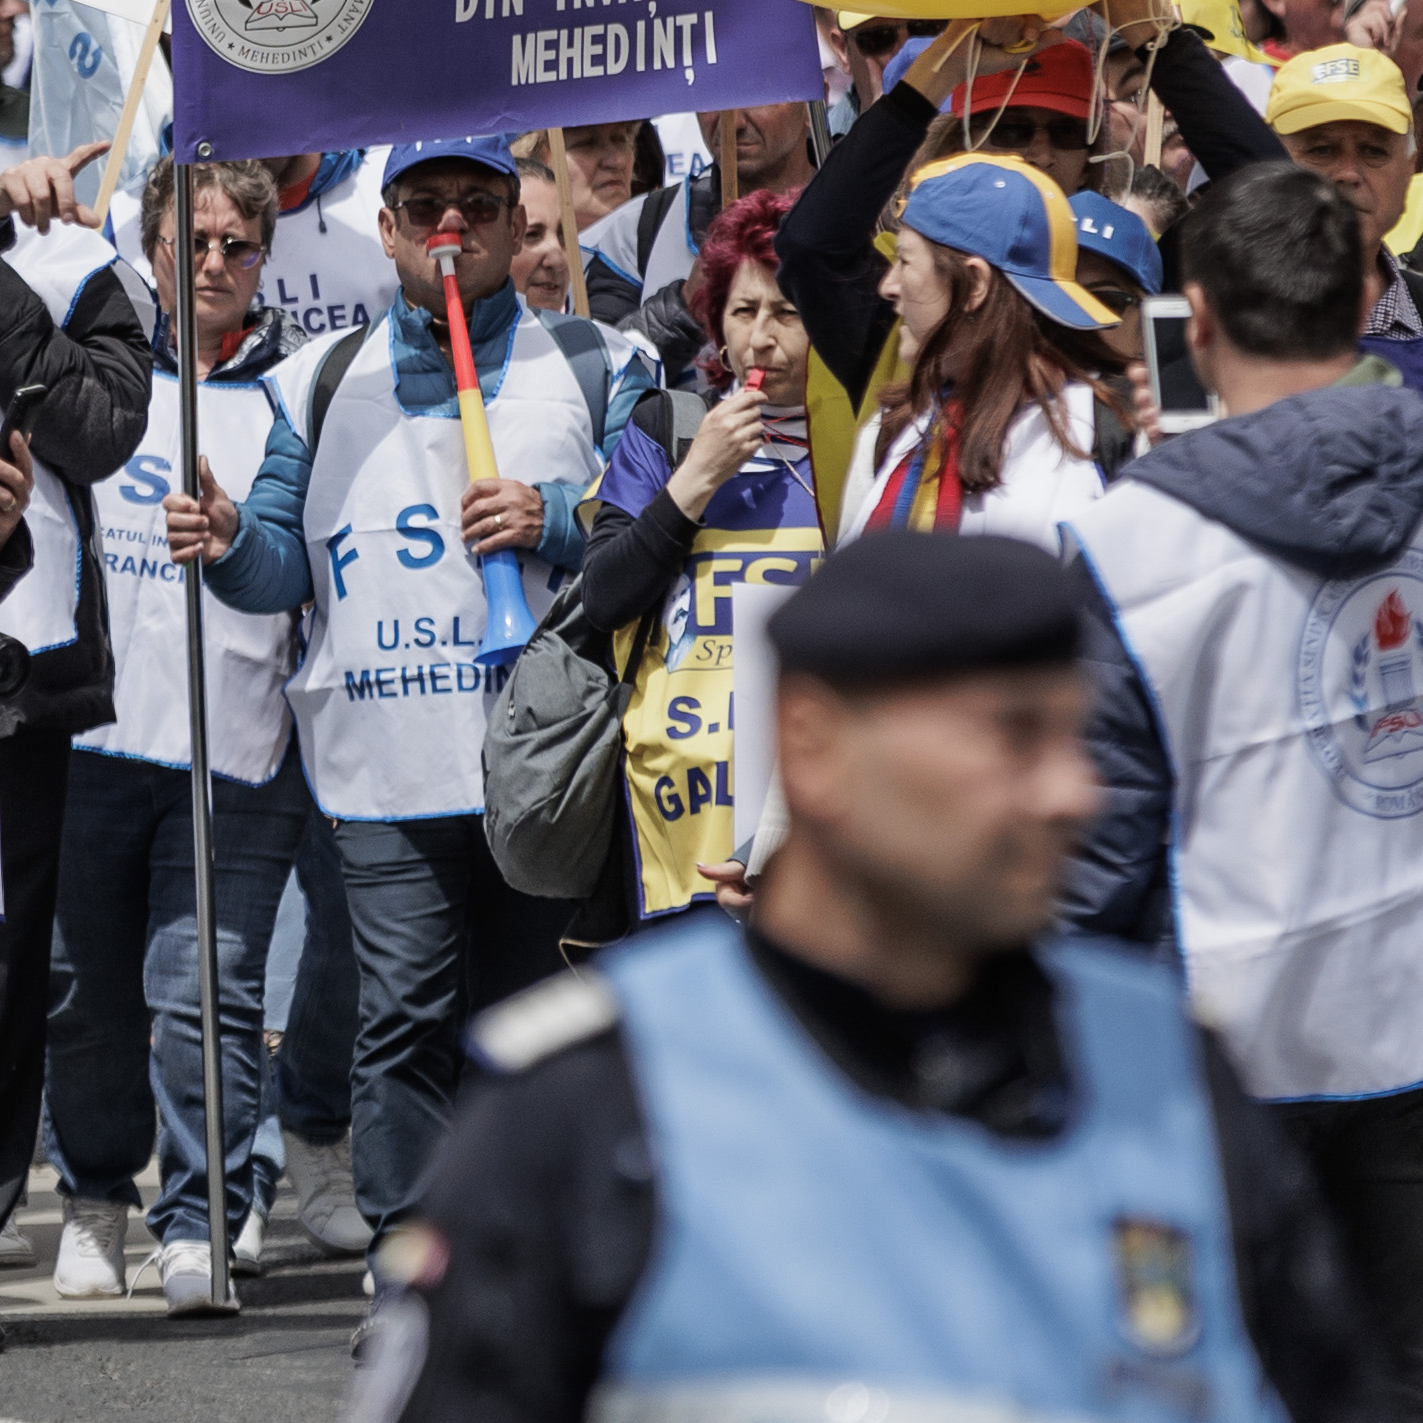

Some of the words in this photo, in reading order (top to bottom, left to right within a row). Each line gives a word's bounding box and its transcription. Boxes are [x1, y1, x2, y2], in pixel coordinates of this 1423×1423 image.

[256, 1, 309, 16] USLI
[237, 40, 324, 65] MEHEDINȚI
[510, 10, 718, 86] MEHEDINȚI
[665, 690, 735, 742] S.
